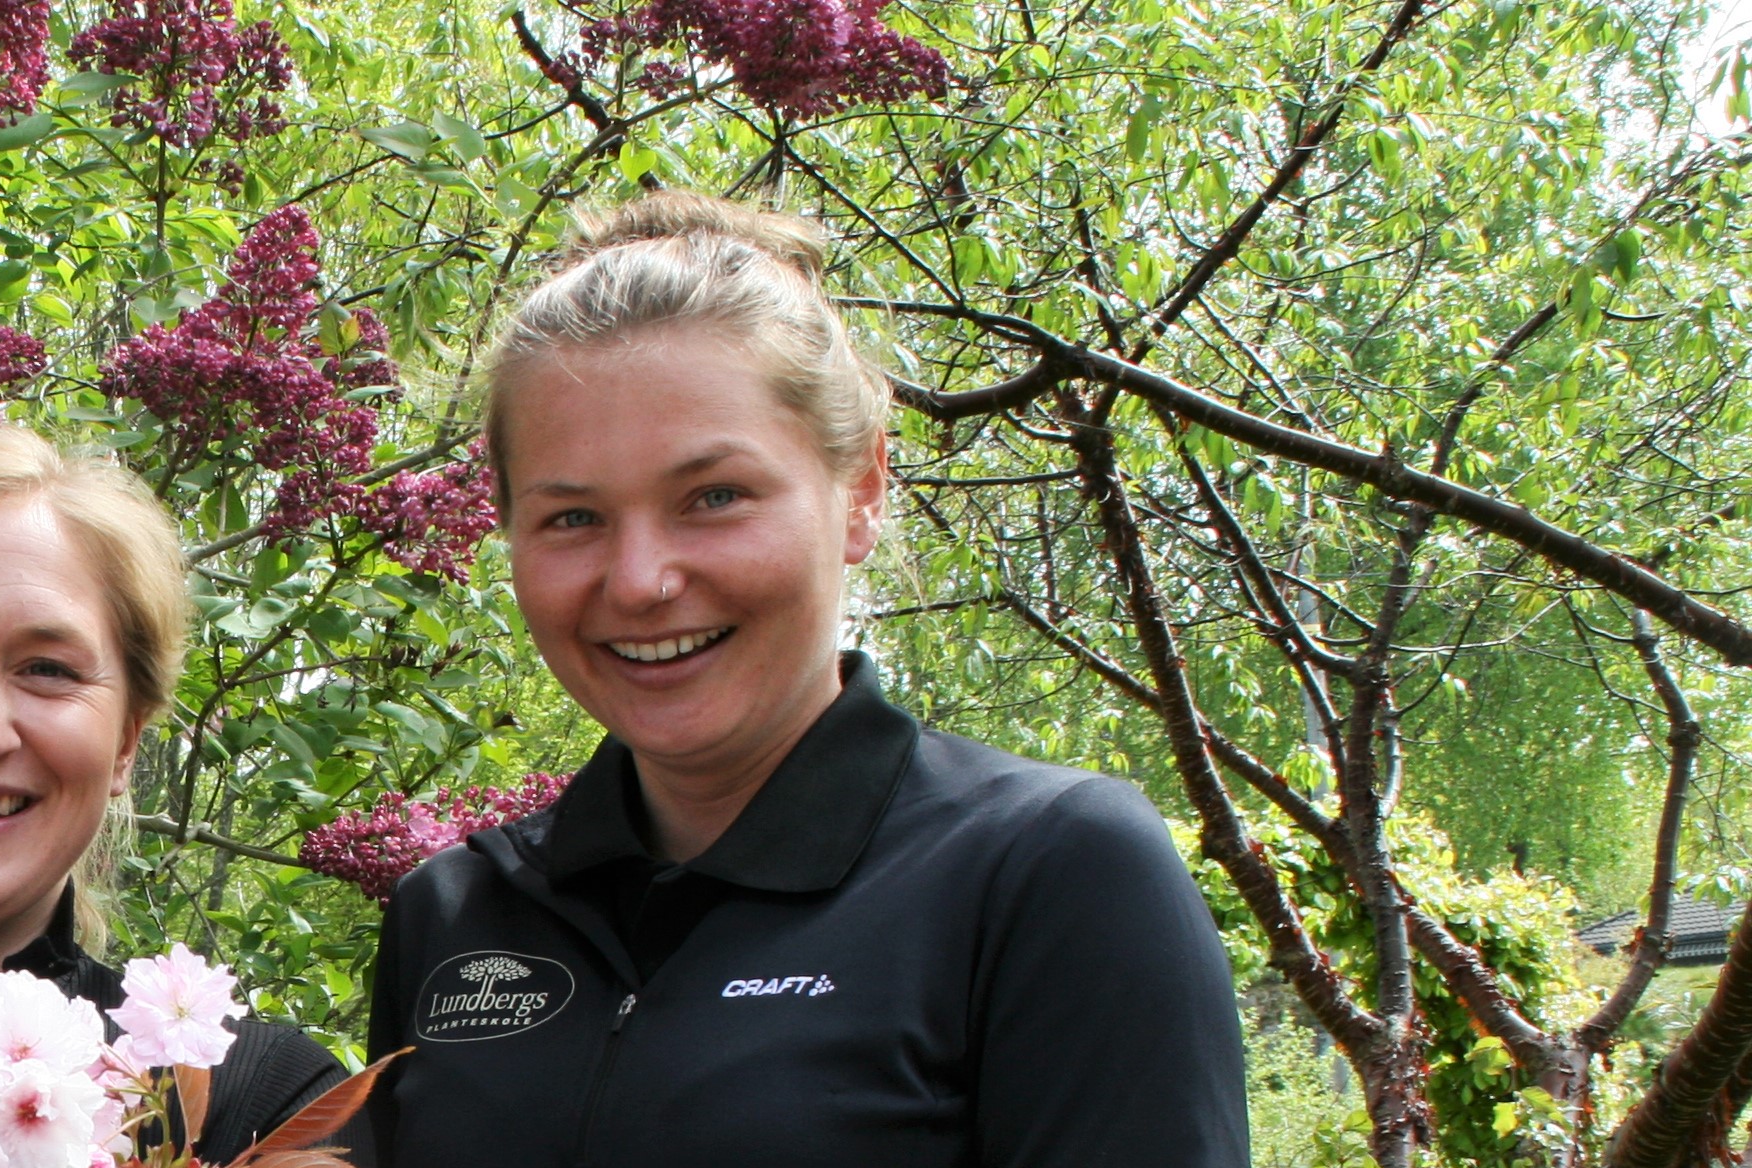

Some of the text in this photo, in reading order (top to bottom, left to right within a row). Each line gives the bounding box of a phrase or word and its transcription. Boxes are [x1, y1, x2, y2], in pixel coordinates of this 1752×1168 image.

[429, 978, 549, 1017] Lundbergs
[721, 975, 815, 998] CRAFT
[426, 1017, 533, 1034] PLANTESKOLE
